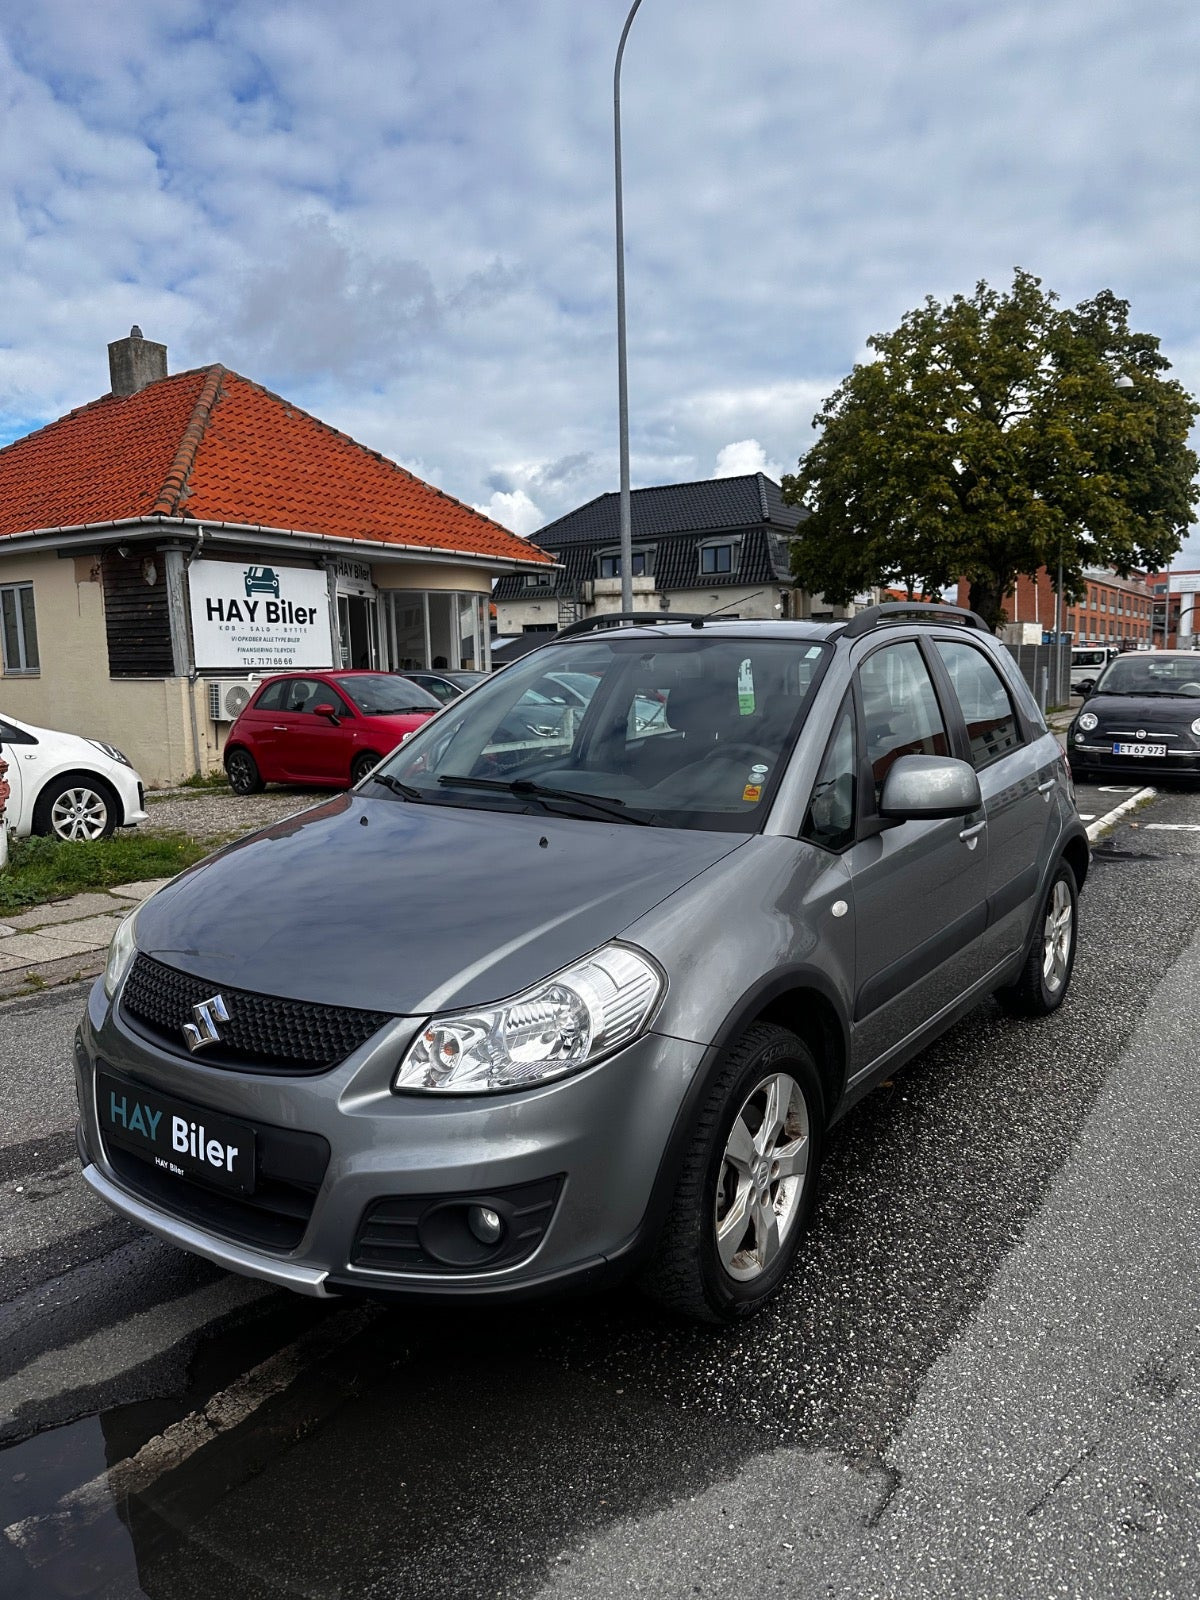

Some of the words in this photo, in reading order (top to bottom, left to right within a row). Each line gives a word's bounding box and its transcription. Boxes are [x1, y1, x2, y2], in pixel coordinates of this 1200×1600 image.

[338, 562, 352, 577] HAY
[354, 564, 369, 581] Biler
[206, 598, 259, 622] HAY
[266, 599, 317, 625] Biler
[1120, 744, 1132, 753] ET
[1134, 745, 1145, 754] 67
[1147, 746, 1165, 755] 973
[110, 1091, 162, 1141] HAY
[172, 1115, 239, 1172] Biler
[154, 1156, 168, 1169] HAY
[169, 1163, 184, 1176] Biler
